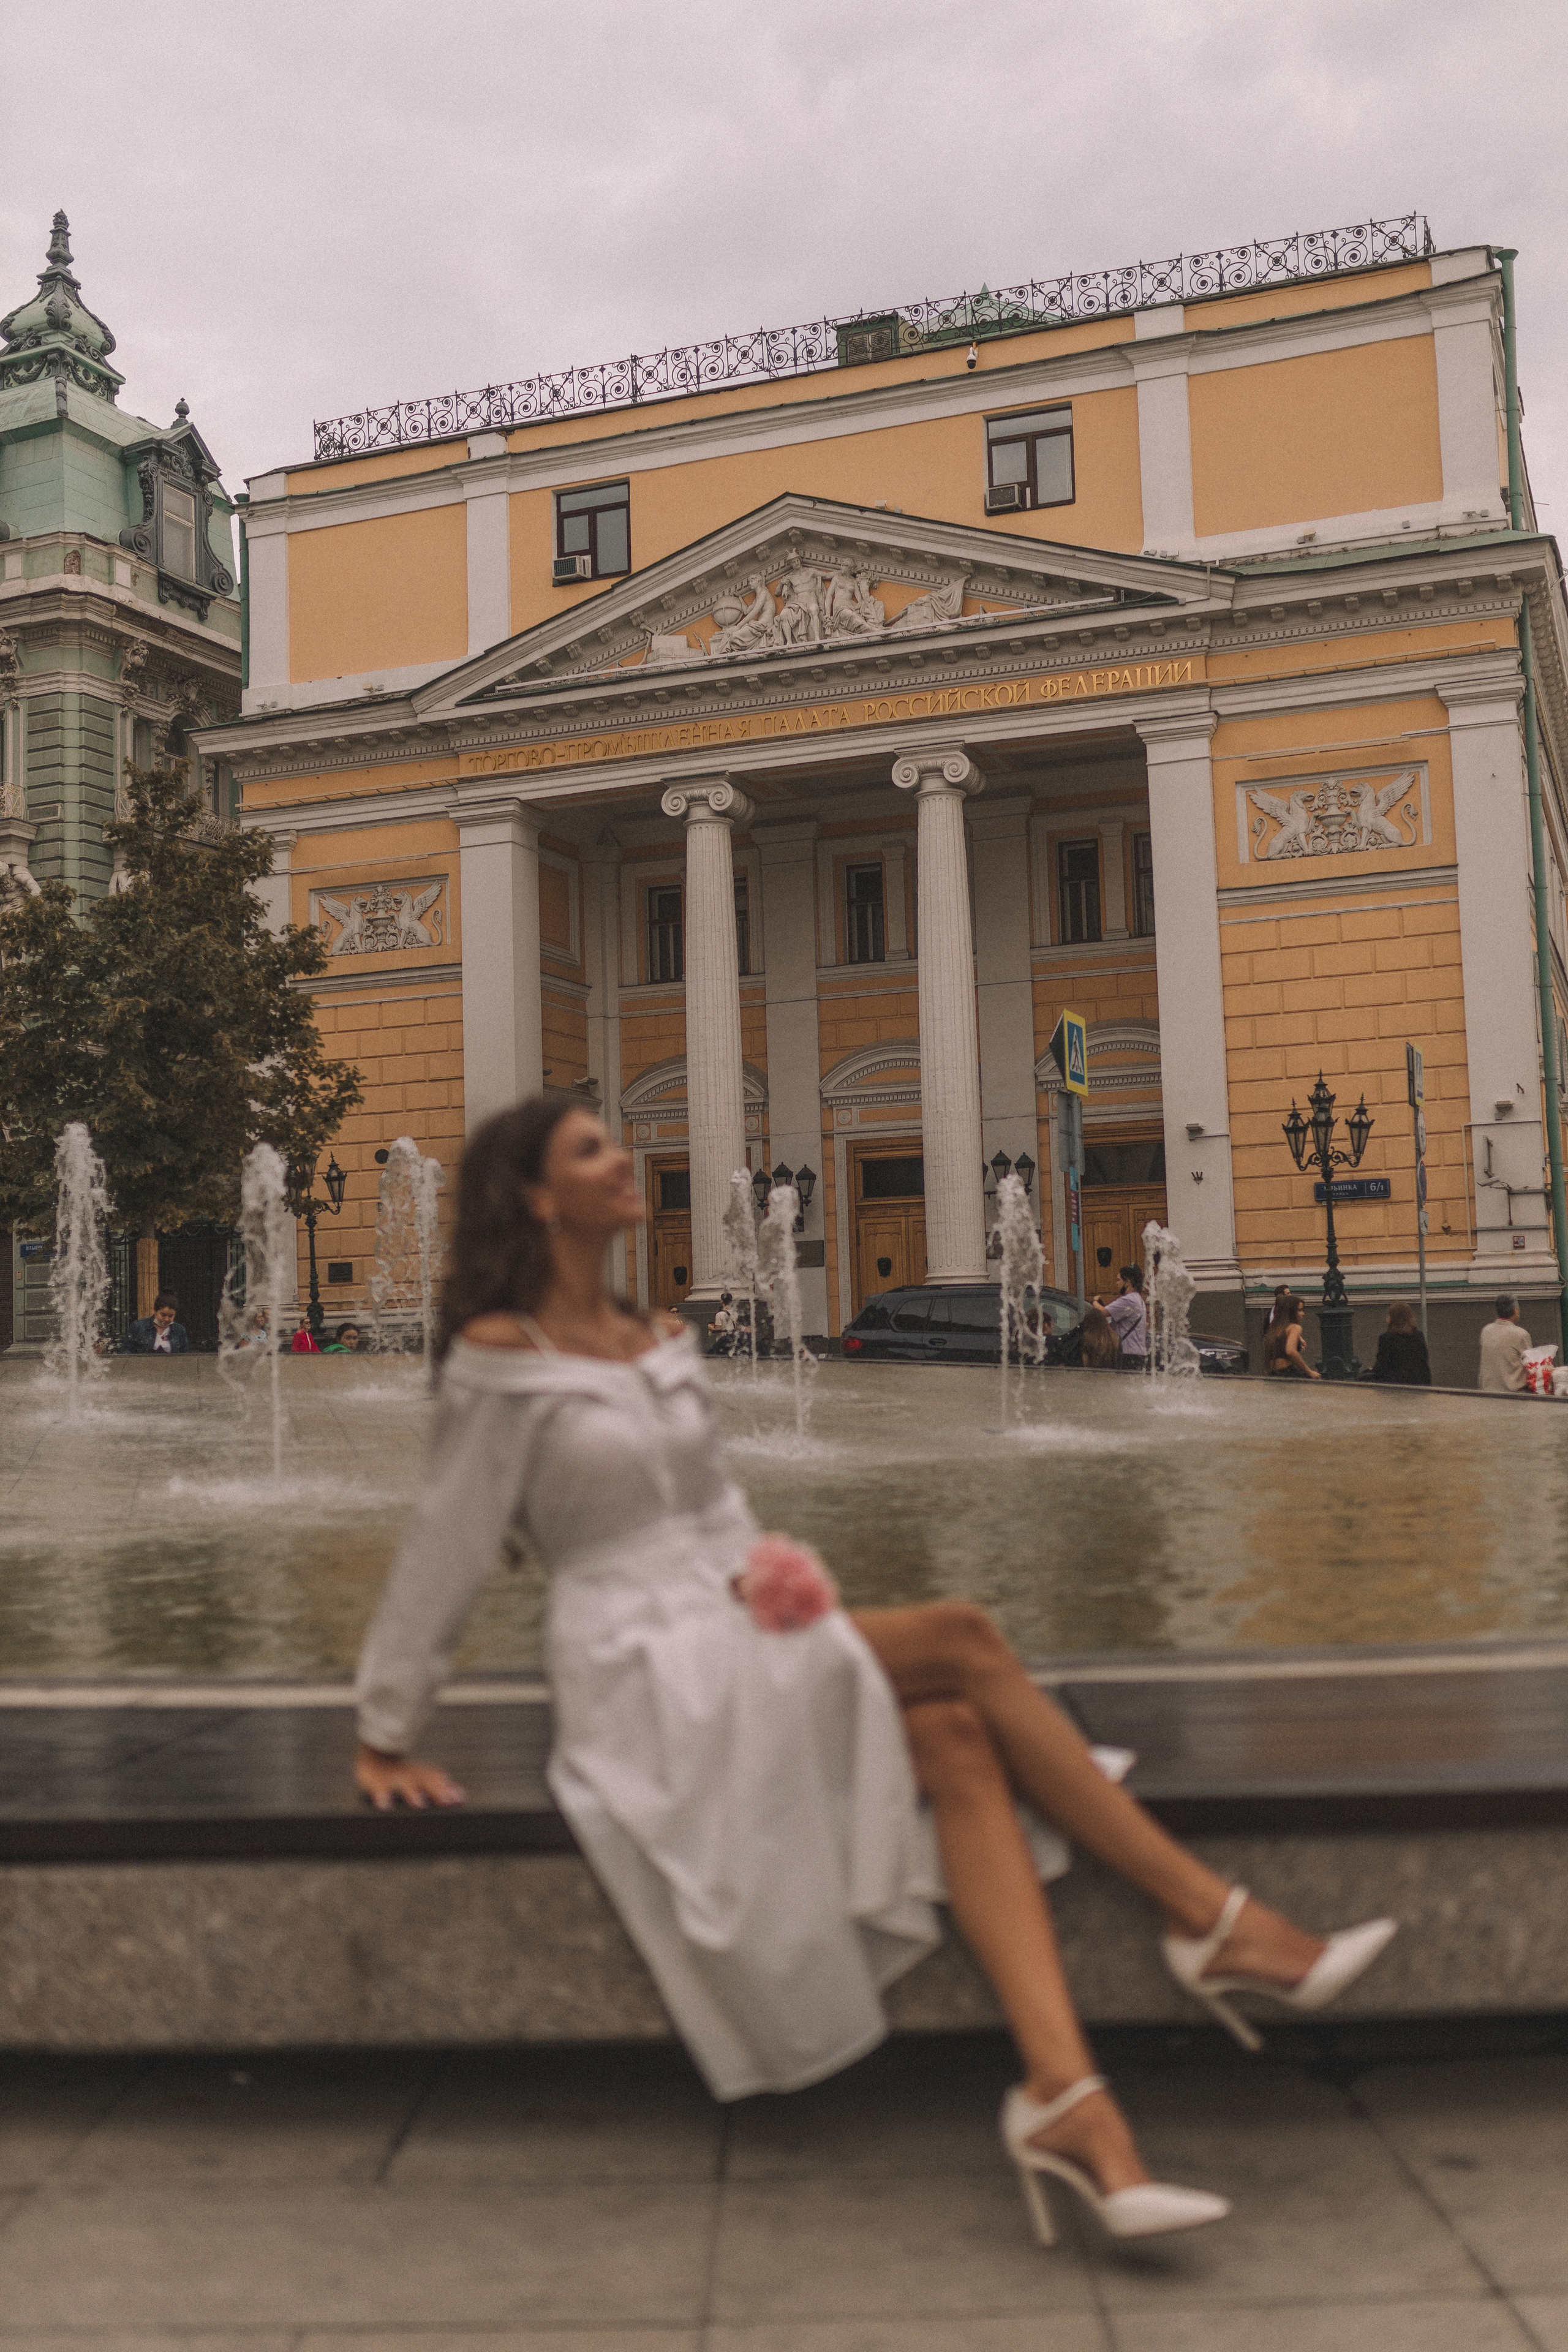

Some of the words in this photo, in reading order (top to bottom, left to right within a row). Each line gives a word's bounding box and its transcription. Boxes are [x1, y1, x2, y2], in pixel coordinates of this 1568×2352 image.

[469, 719, 751, 772] ТОРГОВО-ПРОМЫШЛЕННАЯ
[761, 706, 851, 734] ПАЛАТА
[863, 679, 1030, 721] РОССИЙСКОЙ
[1040, 660, 1193, 698] ФЕДЕРАЦИИ
[1370, 1182, 1384, 1192] 6/1
